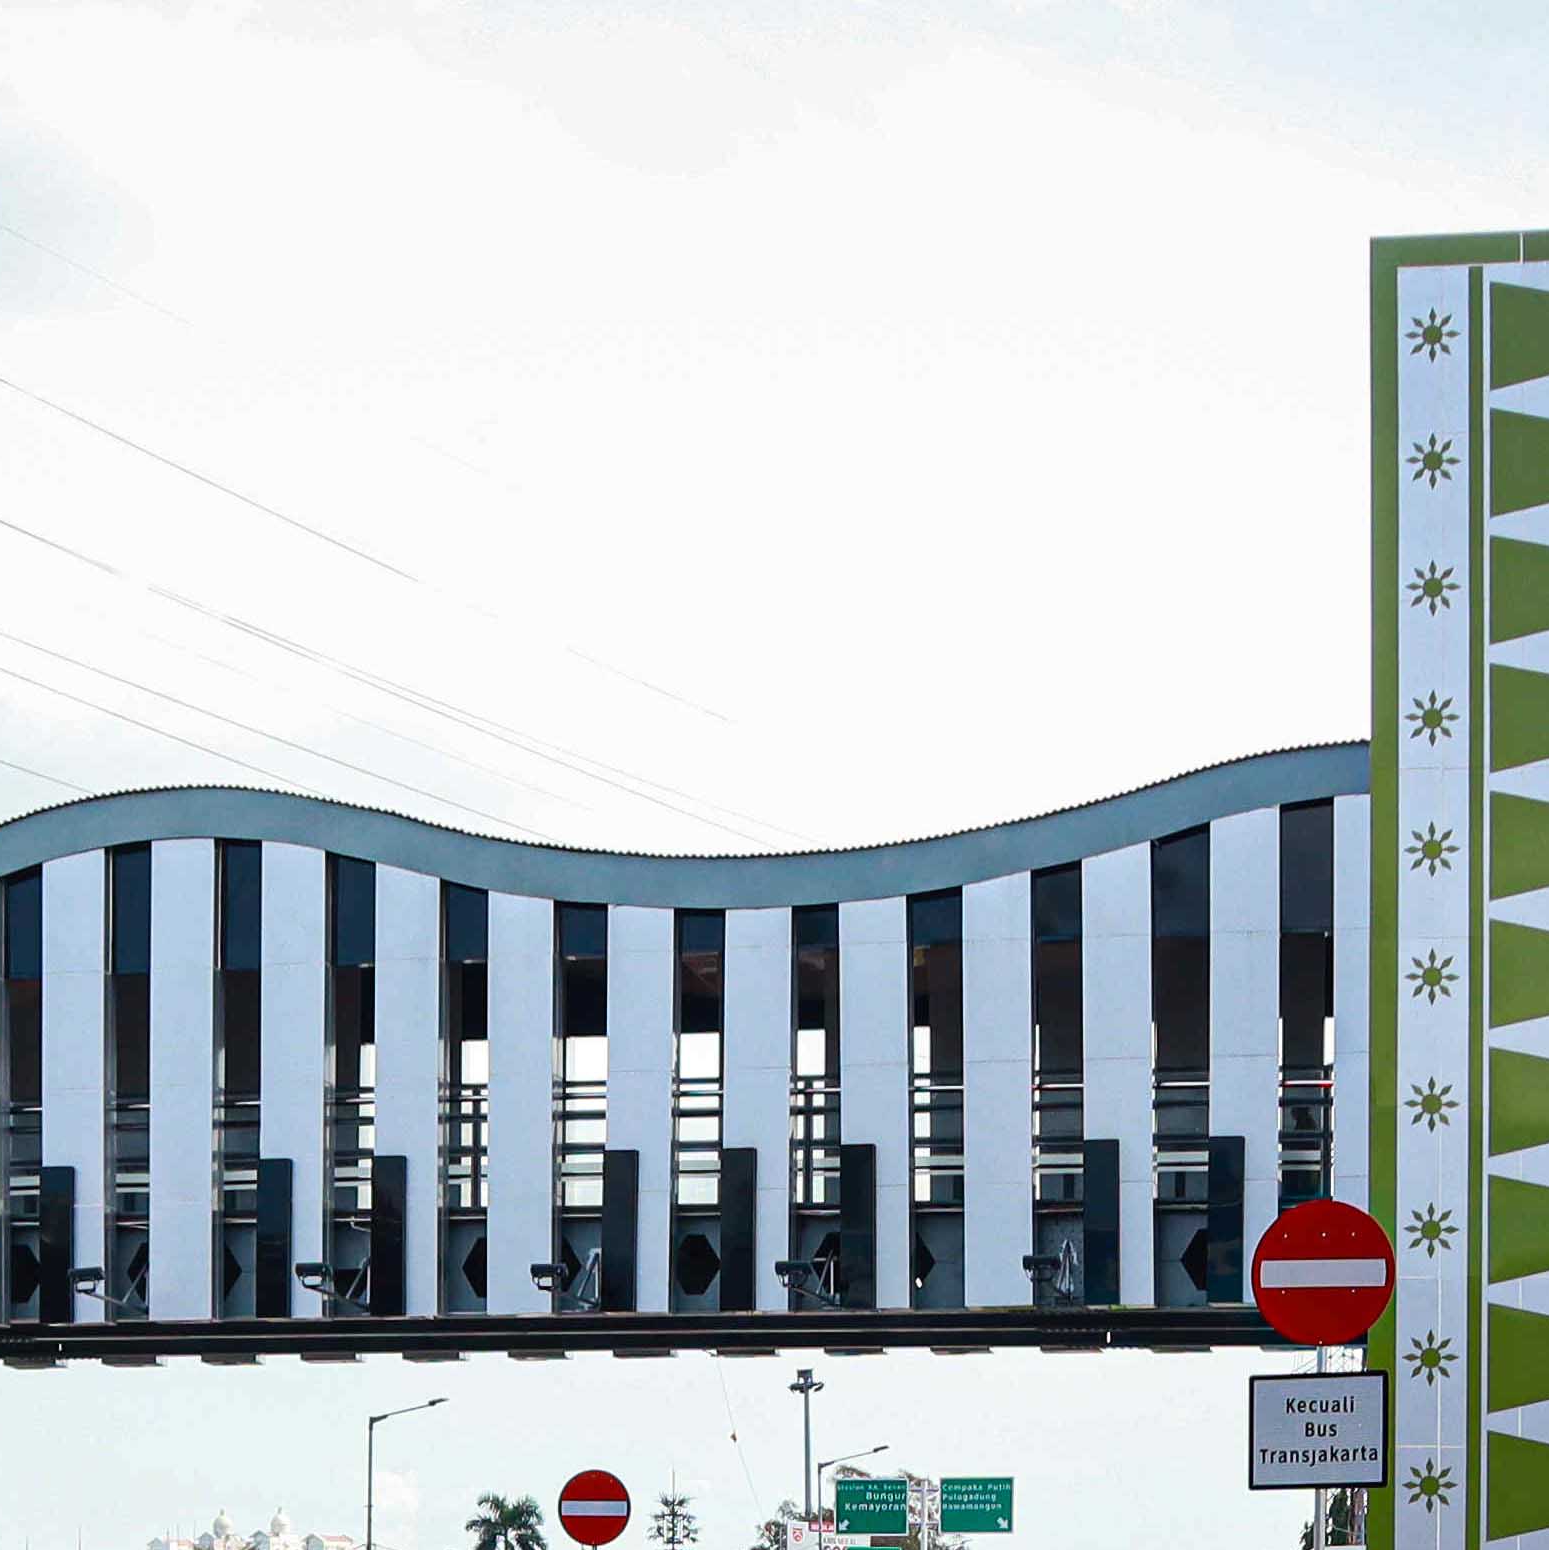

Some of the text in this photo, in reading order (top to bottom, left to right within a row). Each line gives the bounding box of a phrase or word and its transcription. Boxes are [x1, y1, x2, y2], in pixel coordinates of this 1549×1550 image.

[1285, 1395, 1355, 1414] Kecuali
[1304, 1421, 1338, 1438] Bus
[1259, 1445, 1379, 1467] Transjakarta
[865, 1491, 907, 1502] Bungur
[942, 1493, 997, 1503] Pulogadung
[844, 1503, 907, 1513] Kemayoran
